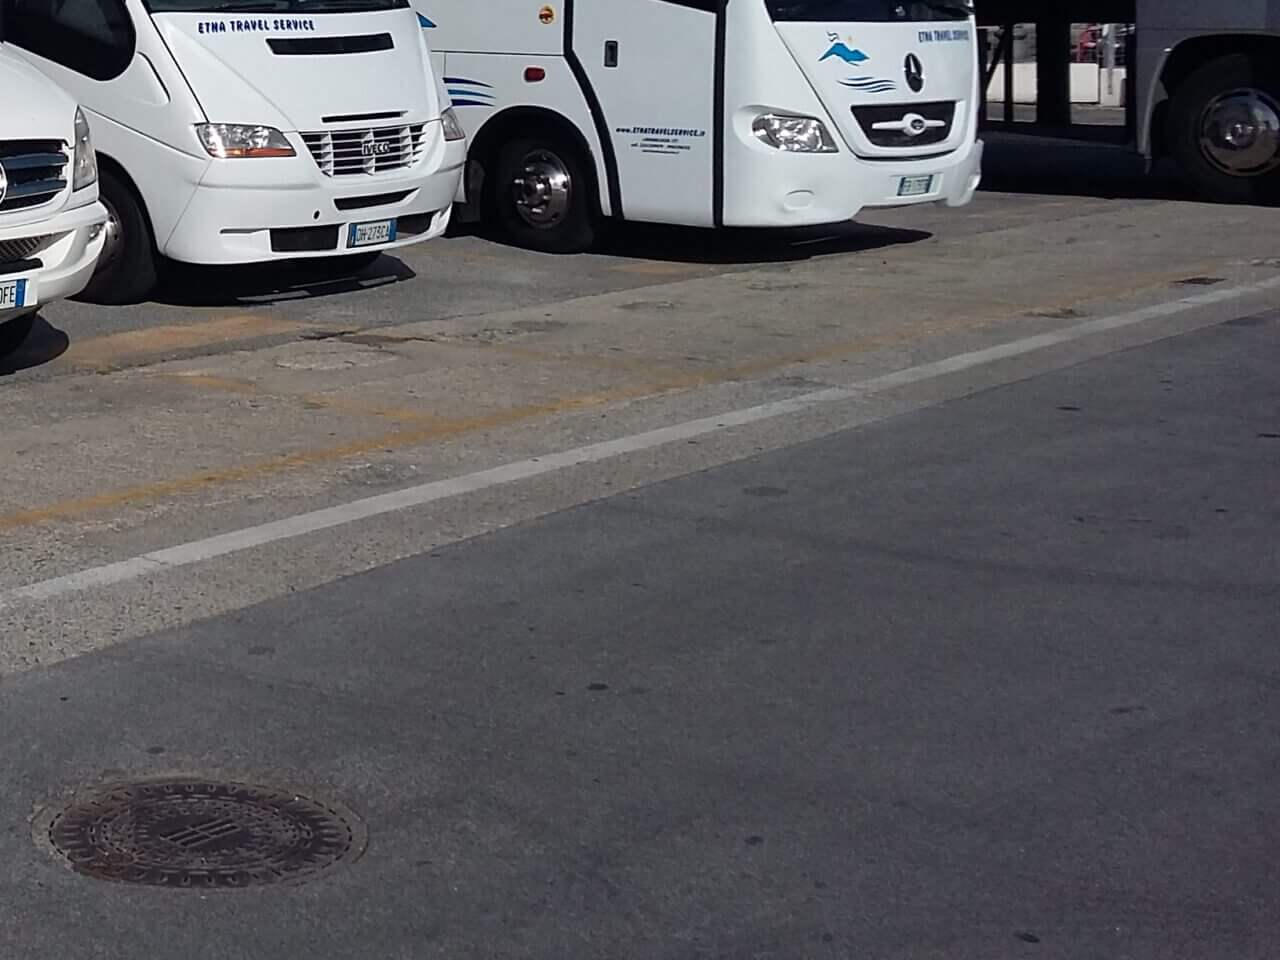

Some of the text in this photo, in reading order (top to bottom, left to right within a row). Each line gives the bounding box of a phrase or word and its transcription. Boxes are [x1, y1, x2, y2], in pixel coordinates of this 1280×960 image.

[198, 19, 315, 34] ETNA TRAVEL SERVICE
[361, 141, 391, 155] IVECO
